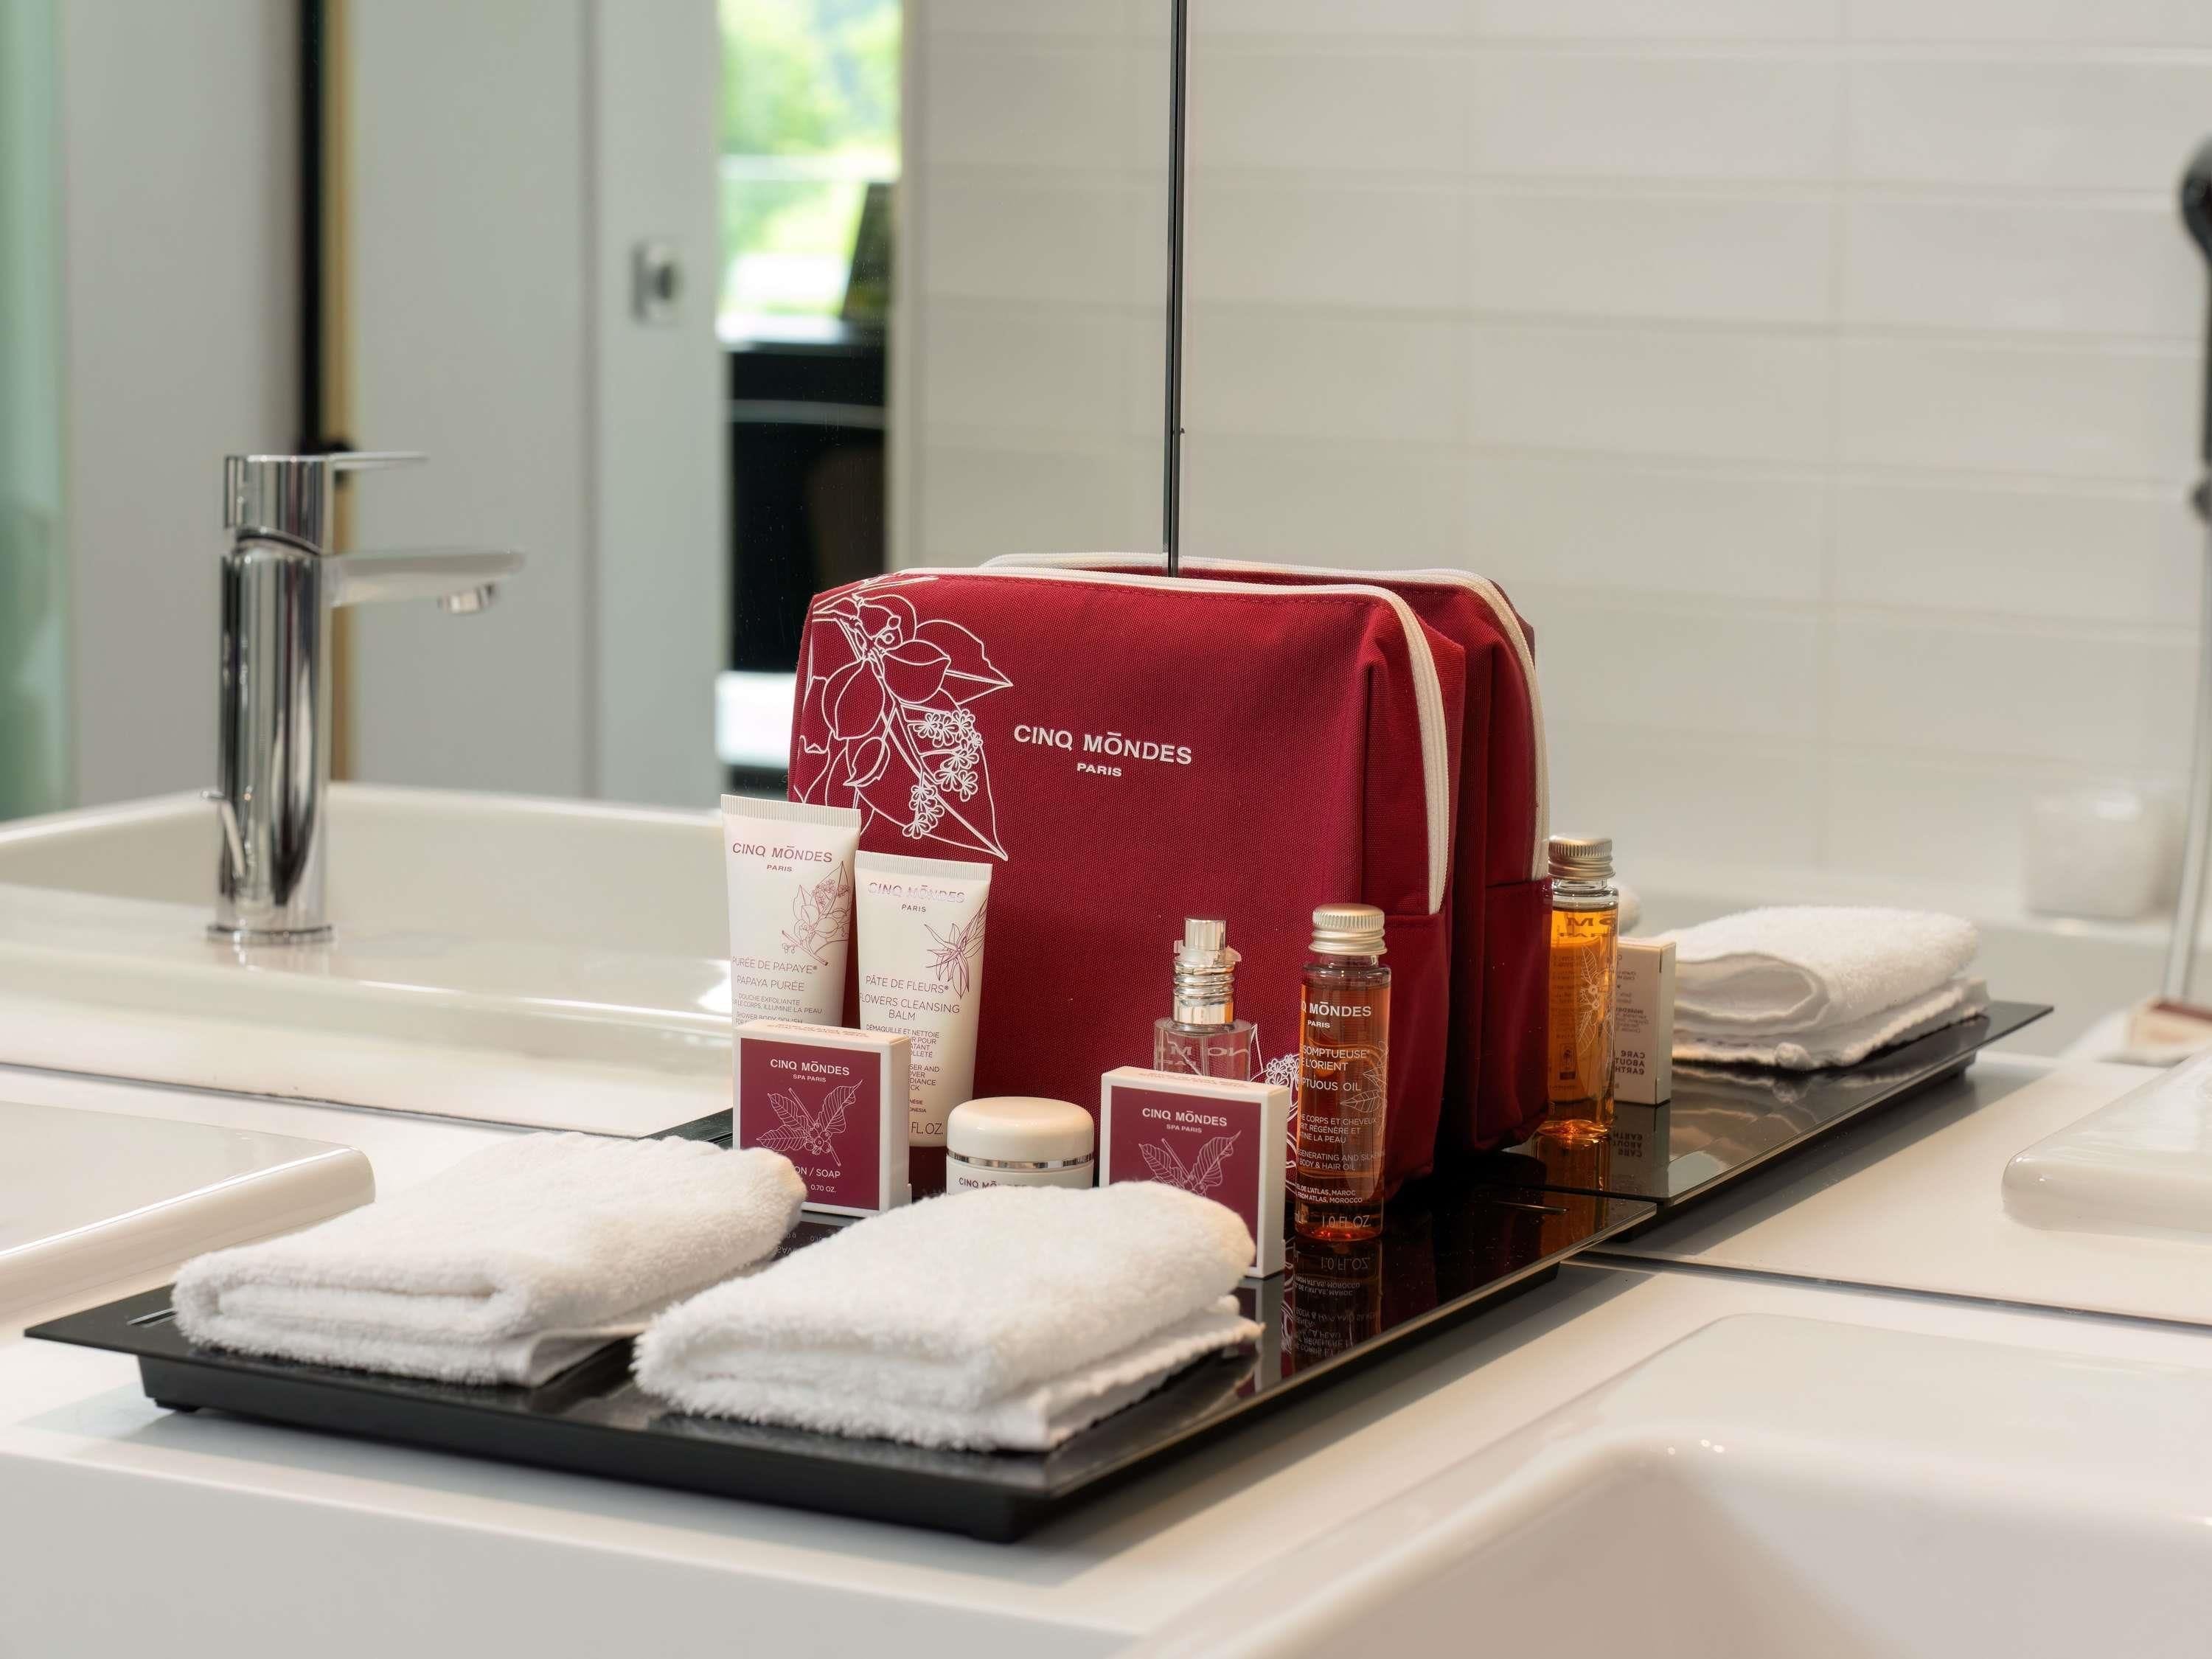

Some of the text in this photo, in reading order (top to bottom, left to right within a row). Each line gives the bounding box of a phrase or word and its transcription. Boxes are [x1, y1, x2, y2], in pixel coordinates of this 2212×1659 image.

[1014, 725, 1192, 765] CINQ MŌNDES
[1077, 762, 1122, 776] PARIS
[732, 843, 832, 863] CINQ MŌNDES
[766, 864, 793, 872] PARIS
[868, 882, 902, 897] CINQ
[901, 904, 927, 913] PARIS
[757, 961, 771, 970] DE
[737, 975, 805, 992] PAPAYA PURÉE
[866, 975, 888, 987] PÂTE
[891, 979, 904, 988] DE
[901, 999, 960, 1014] CLEANSING
[1309, 1001, 1371, 1017] MŌNDES
[888, 1009, 916, 1021] BALM
[1307, 1020, 1331, 1029] PARIS
[912, 1029, 939, 1038] NETTOIE
[770, 1059, 850, 1076] CINQ MŌNDES
[1306, 1058, 1349, 1071] L'ORIENT
[1343, 1082, 1361, 1091] OIL
[1142, 1107, 1228, 1127] CINQ MŌNDES
[1306, 1114, 1329, 1124] CORPS
[1181, 1125, 1203, 1133] PARIS
[1325, 1135, 1346, 1144] PEAU
[1342, 1153, 1359, 1162] AND
[1322, 1162, 1340, 1170] HAIR
[1343, 1163, 1355, 1171] OIL
[815, 1169, 841, 1178] SOAP
[959, 1178, 978, 1189] CINQ
